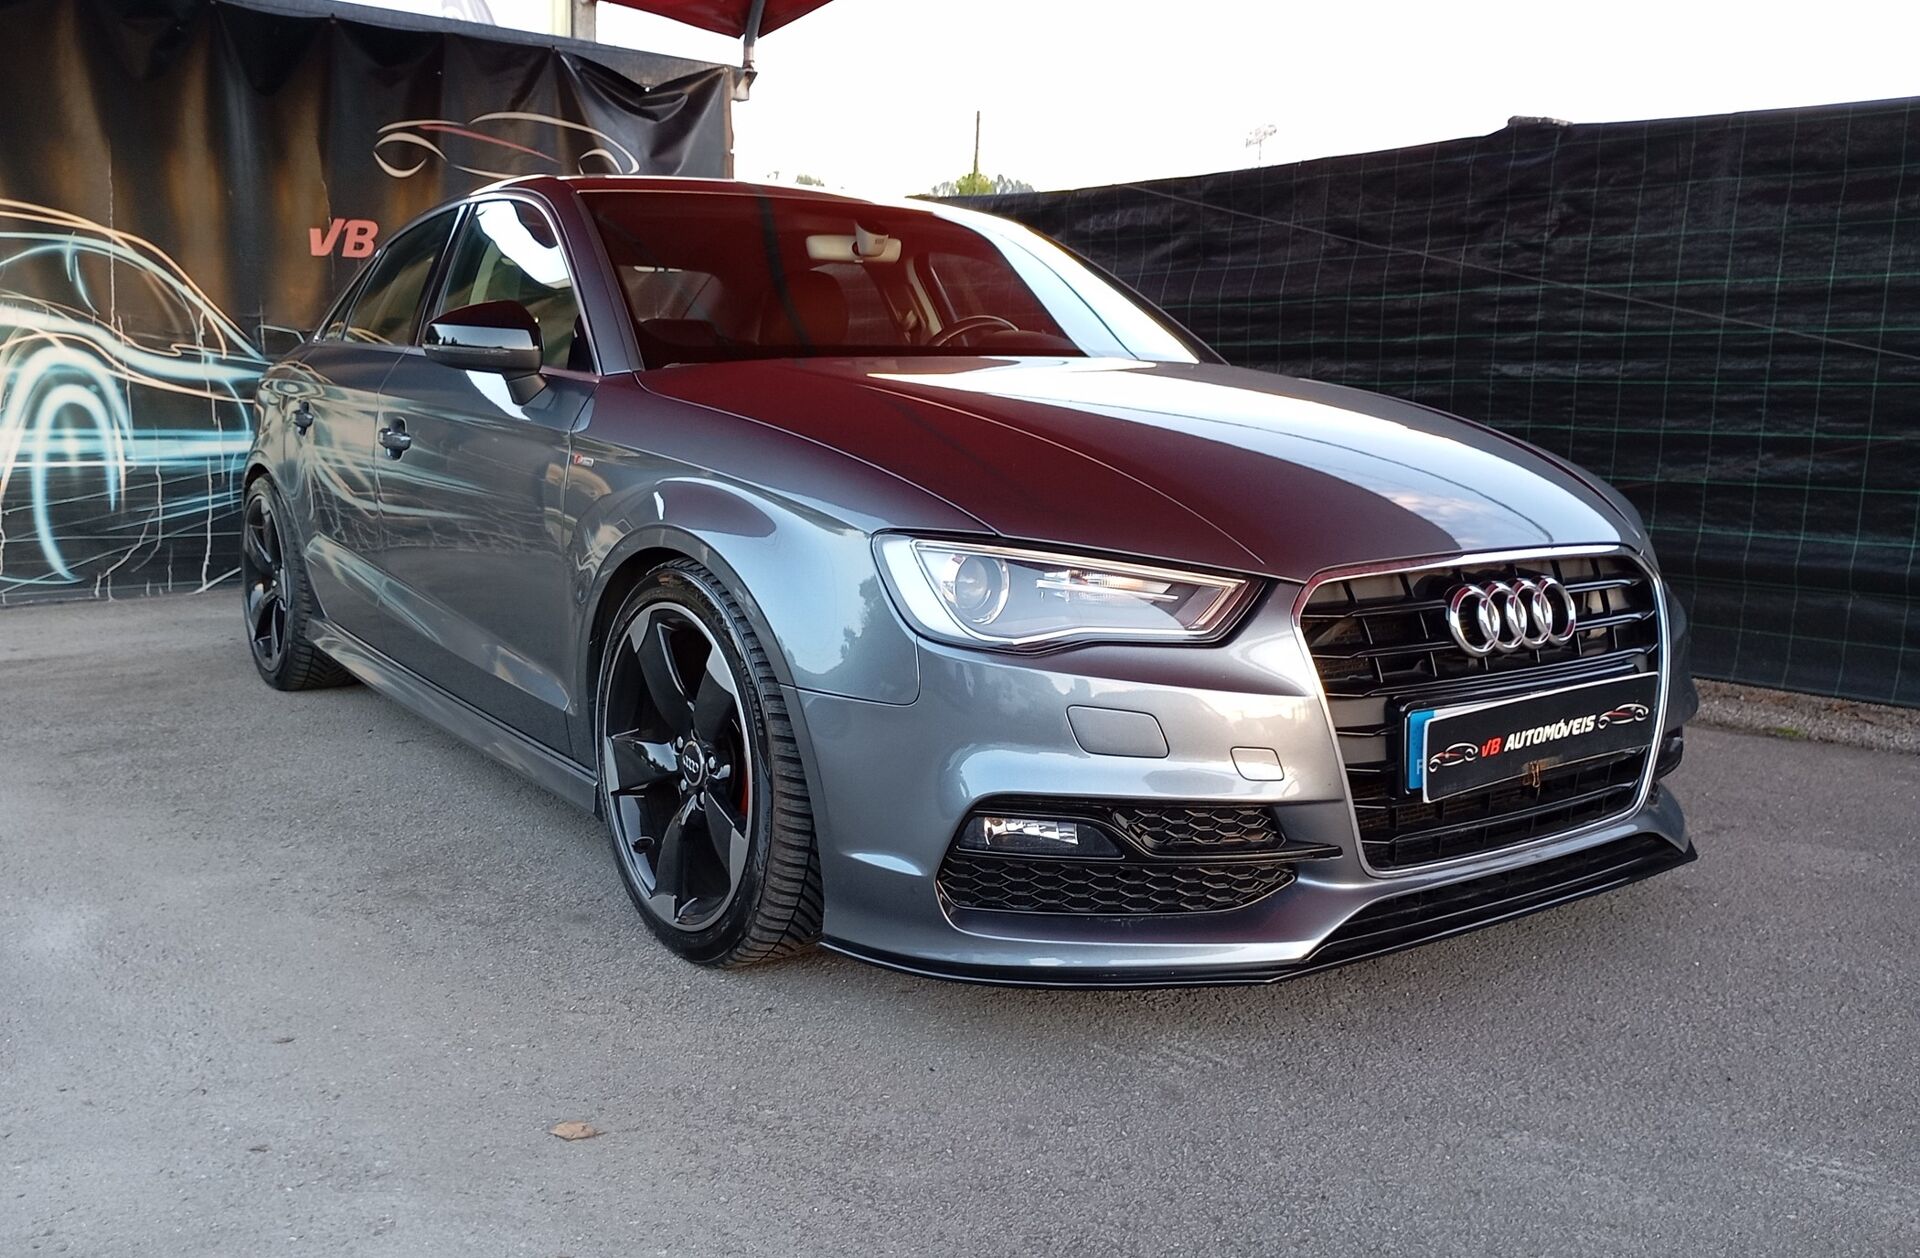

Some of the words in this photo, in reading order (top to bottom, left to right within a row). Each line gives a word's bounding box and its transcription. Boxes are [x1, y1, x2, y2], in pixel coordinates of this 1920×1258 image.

[309, 218, 379, 257] VB
[1481, 738, 1502, 757] VB
[1504, 715, 1596, 752] AUTOMÓVEIS
